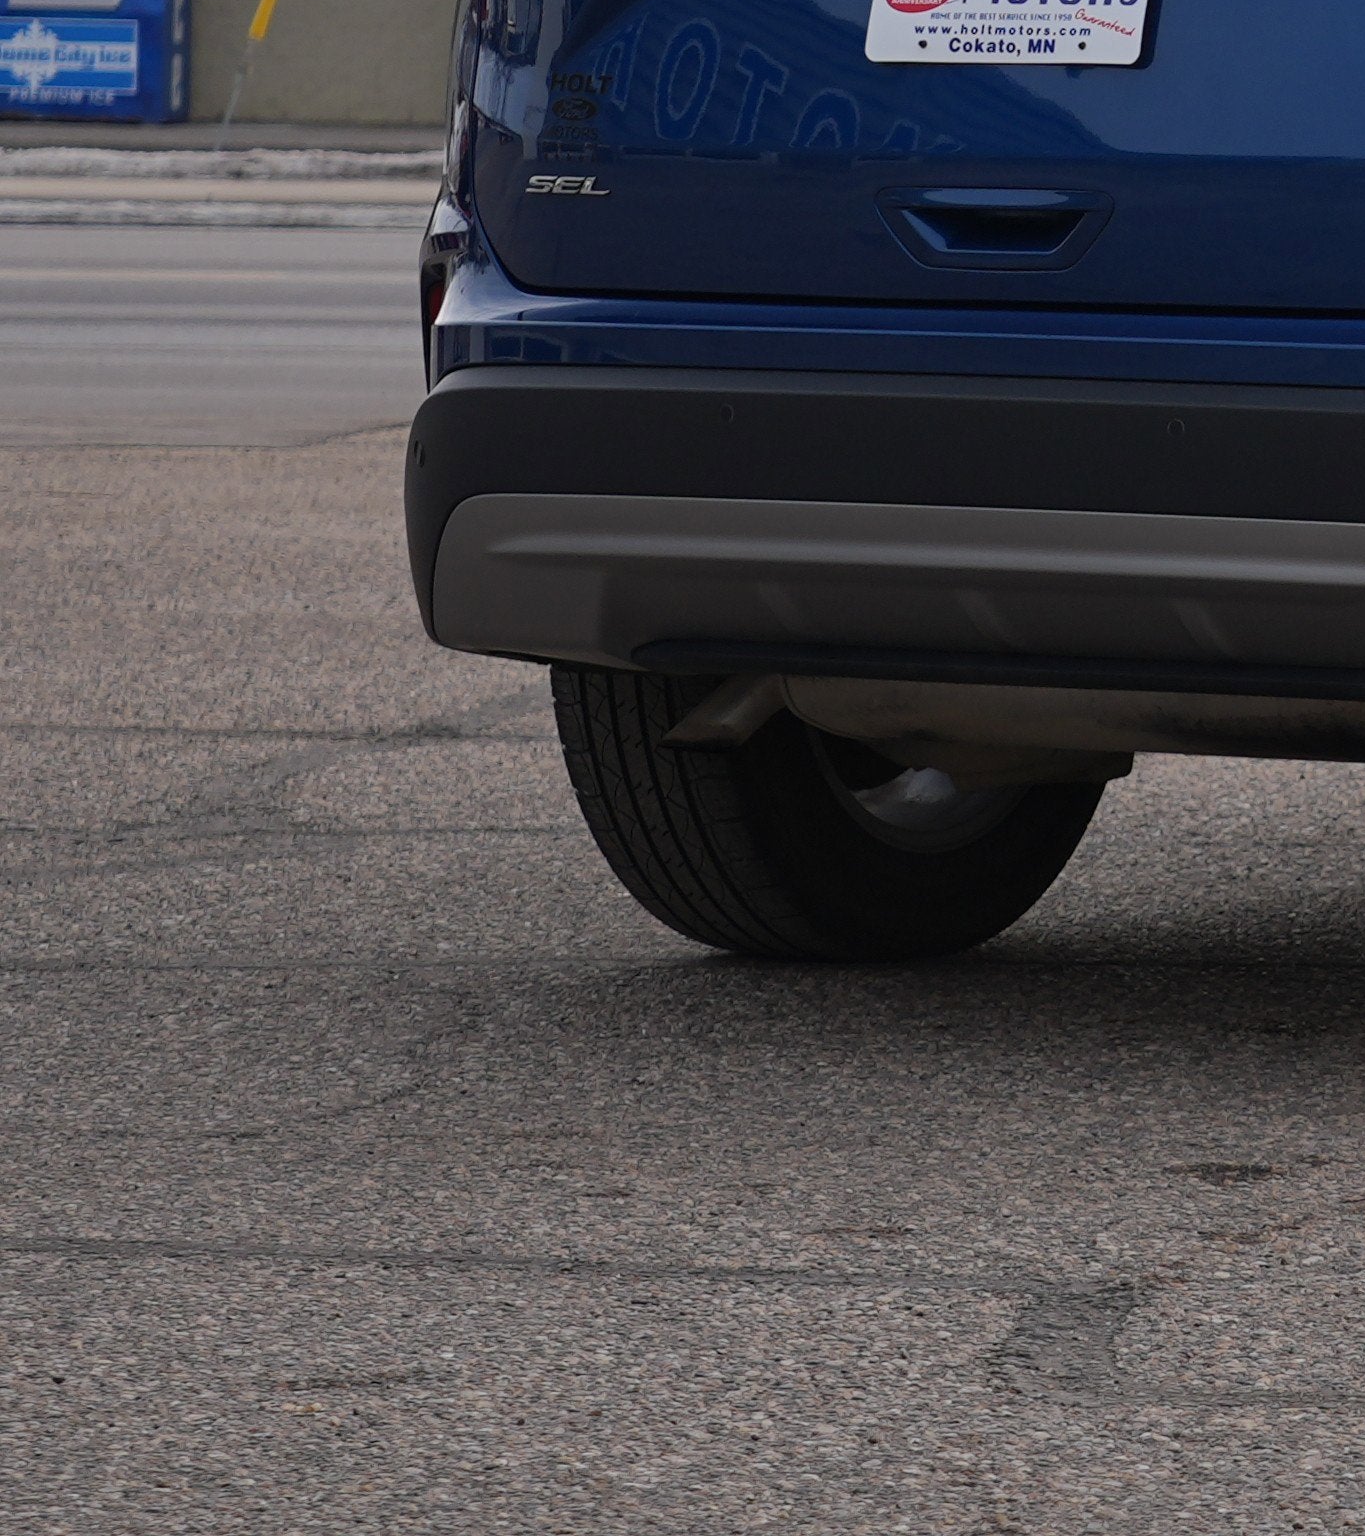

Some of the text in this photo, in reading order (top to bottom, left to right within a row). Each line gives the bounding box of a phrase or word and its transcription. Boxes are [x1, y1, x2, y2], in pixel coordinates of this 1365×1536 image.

[930, 12, 951, 20] HOME
[953, 12, 962, 20] OF
[964, 12, 978, 20] THE
[980, 12, 997, 21] BEST
[998, 13, 1028, 21] SERVICE
[1030, 13, 1051, 21] SINCE
[1074, 8, 1136, 37] Guaranteed
[914, 24, 1091, 36] www.holtmotors.com
[948, 37, 1056, 57] Cokato, MN
[550, 72, 613, 94] HOLT
[525, 175, 611, 196] SEL
